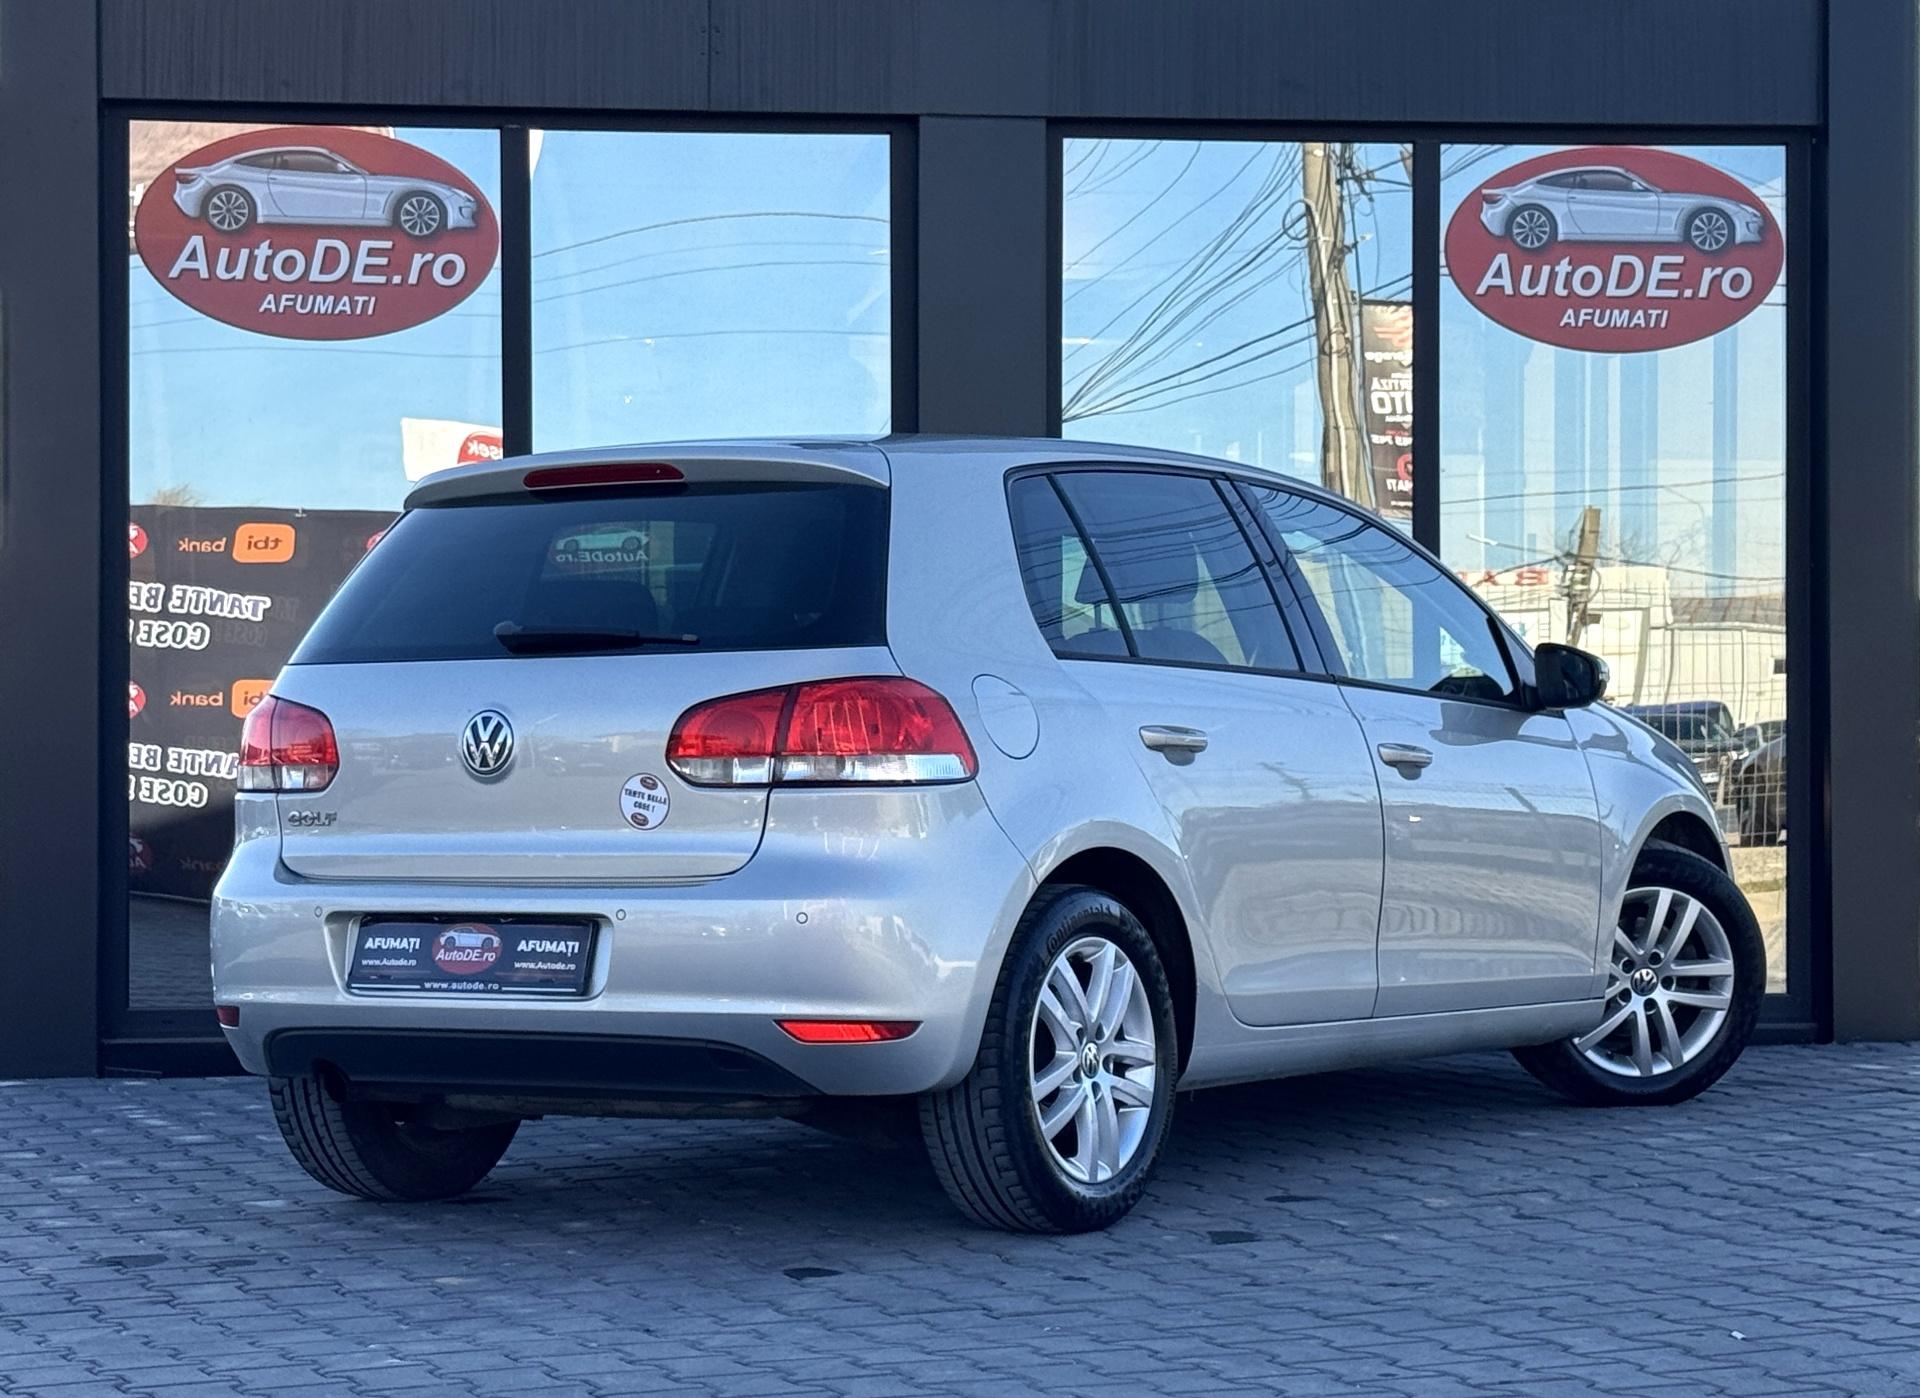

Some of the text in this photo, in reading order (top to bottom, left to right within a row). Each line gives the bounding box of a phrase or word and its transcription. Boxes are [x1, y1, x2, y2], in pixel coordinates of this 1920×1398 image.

[168, 235, 467, 287] AutoDE.ro
[1475, 253, 1753, 300] AutoDE.ro
[259, 293, 376, 316] AFUMATI
[1559, 308, 1668, 329] AFUMATI
[288, 811, 337, 827] GOLF
[435, 948, 496, 962] AutoDE.ro
